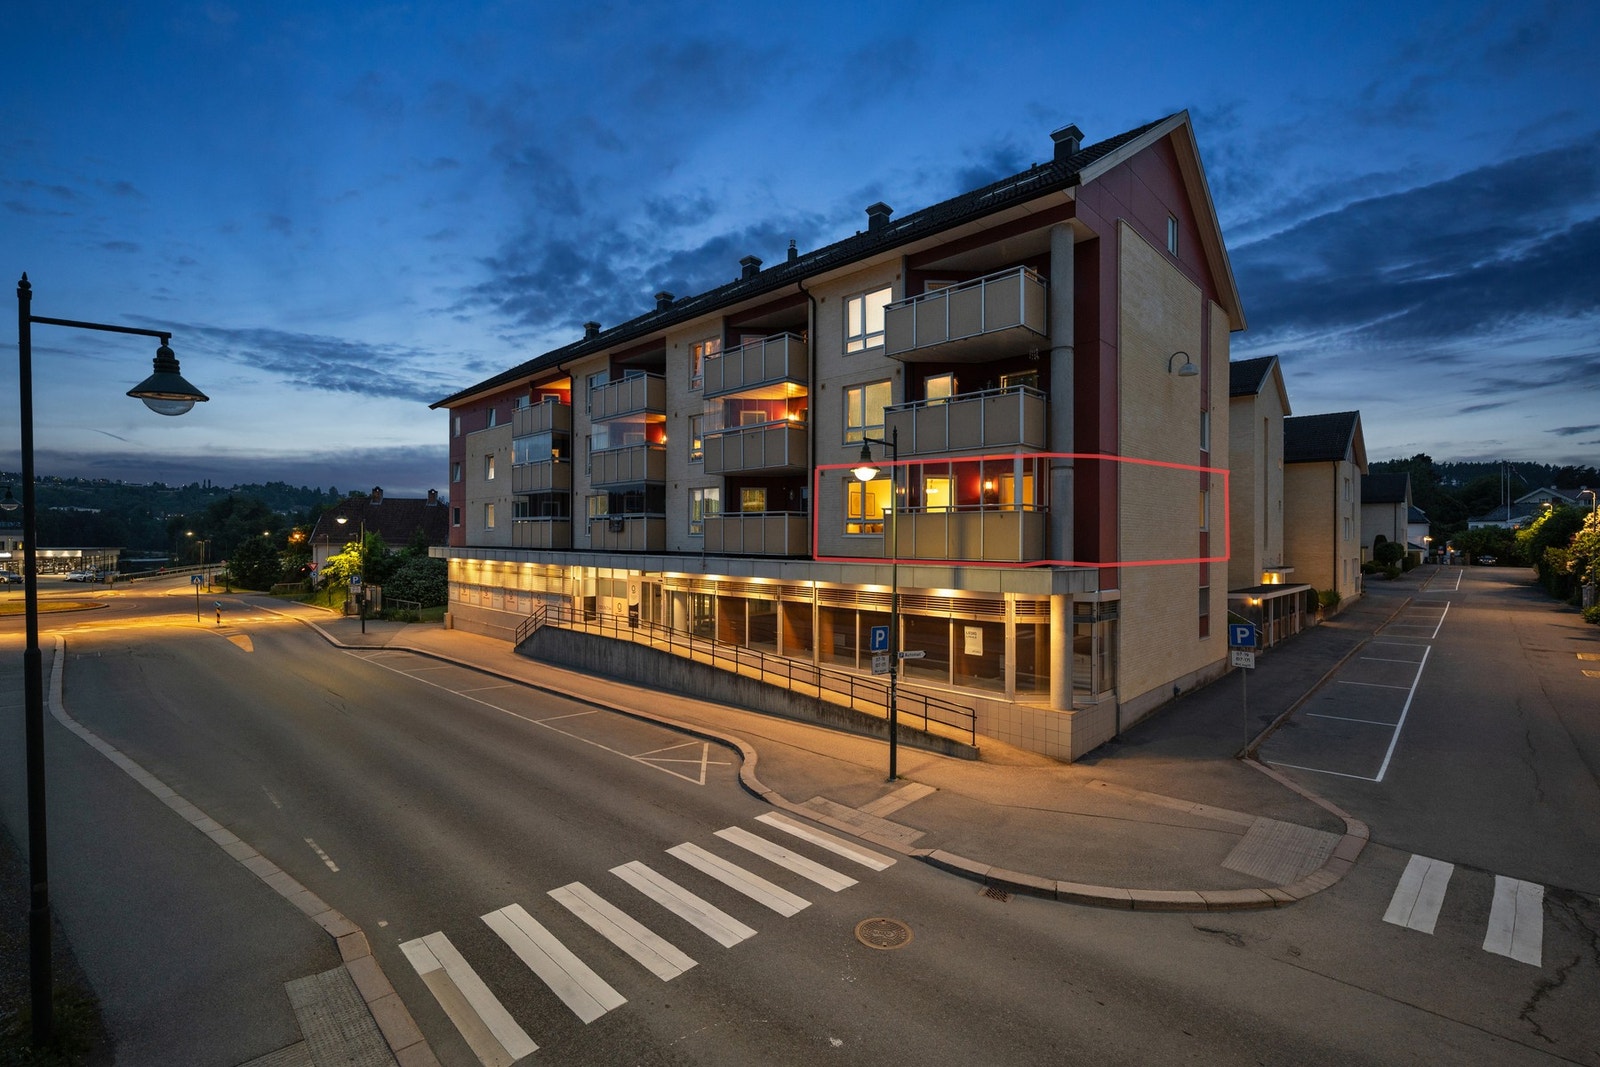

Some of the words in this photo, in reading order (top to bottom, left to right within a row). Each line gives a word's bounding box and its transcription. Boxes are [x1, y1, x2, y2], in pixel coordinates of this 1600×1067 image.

[352, 576, 359, 584] P
[875, 630, 885, 648] P
[1236, 627, 1250, 644] P
